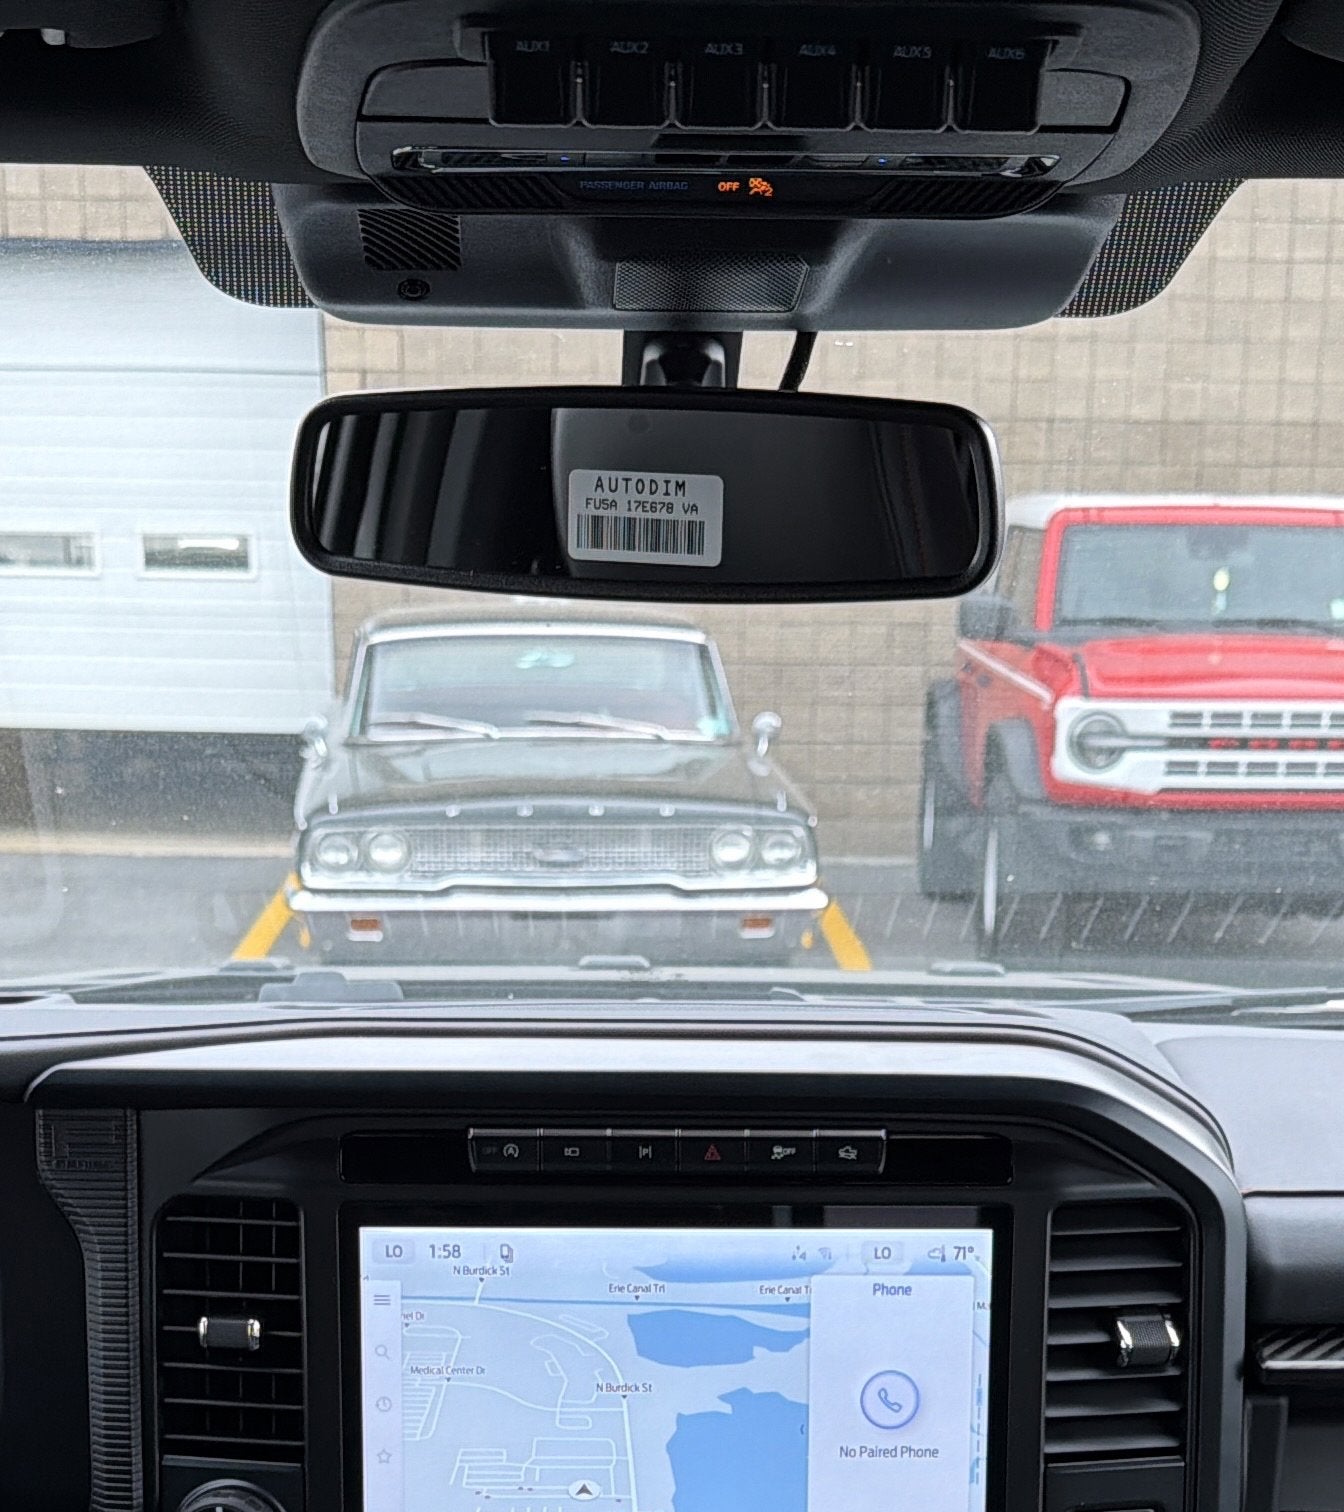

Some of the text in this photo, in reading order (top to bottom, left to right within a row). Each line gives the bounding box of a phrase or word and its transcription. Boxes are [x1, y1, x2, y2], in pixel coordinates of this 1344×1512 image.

[609, 40, 649, 54] AUX2
[705, 42, 743, 55] AUX3
[580, 181, 740, 192] PASSENGER AIRBAG OFF
[594, 476, 686, 497] AUTODIM
[627, 500, 674, 514] 17E678
[682, 503, 699, 515] VA
[385, 1244, 461, 1259] LO 1:58
[874, 1247, 891, 1260] LO
[453, 1265, 510, 1276] N Burdick St
[609, 1283, 625, 1293] Erie
[627, 1283, 651, 1293] Canal
[759, 1285, 802, 1295] Erie Canal
[873, 1283, 912, 1296] Phone
[410, 1366, 443, 1375] Medical
[446, 1366, 474, 1375] Center
[596, 1382, 652, 1393] N Burdick St
[840, 1445, 939, 1458] No Paired Phone
